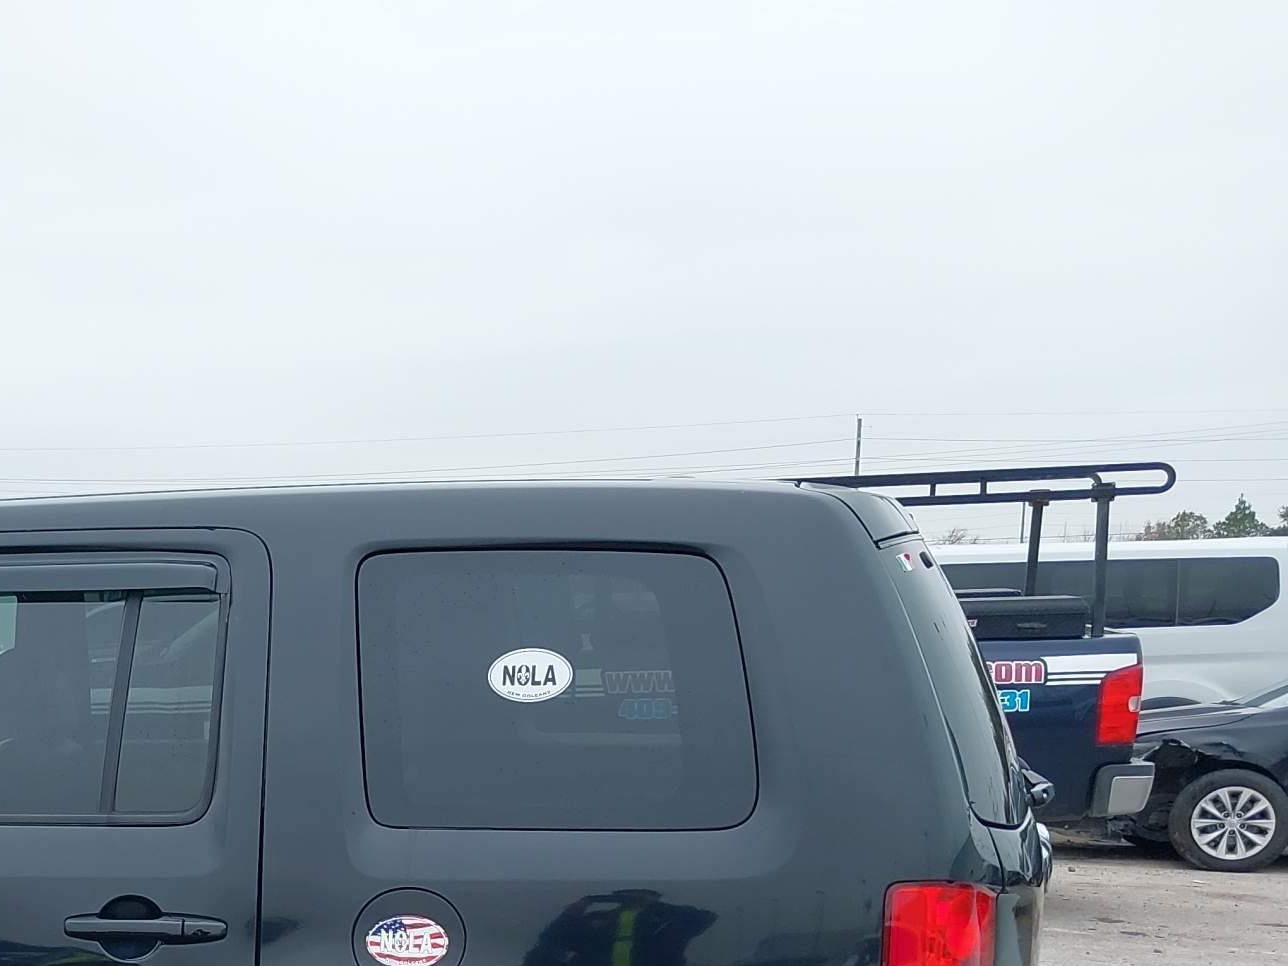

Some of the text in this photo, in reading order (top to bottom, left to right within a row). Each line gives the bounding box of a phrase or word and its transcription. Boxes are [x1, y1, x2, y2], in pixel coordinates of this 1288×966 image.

[503, 664, 557, 686] NOLA
[997, 690, 1030, 712] 31
[380, 929, 432, 953] NOLA
